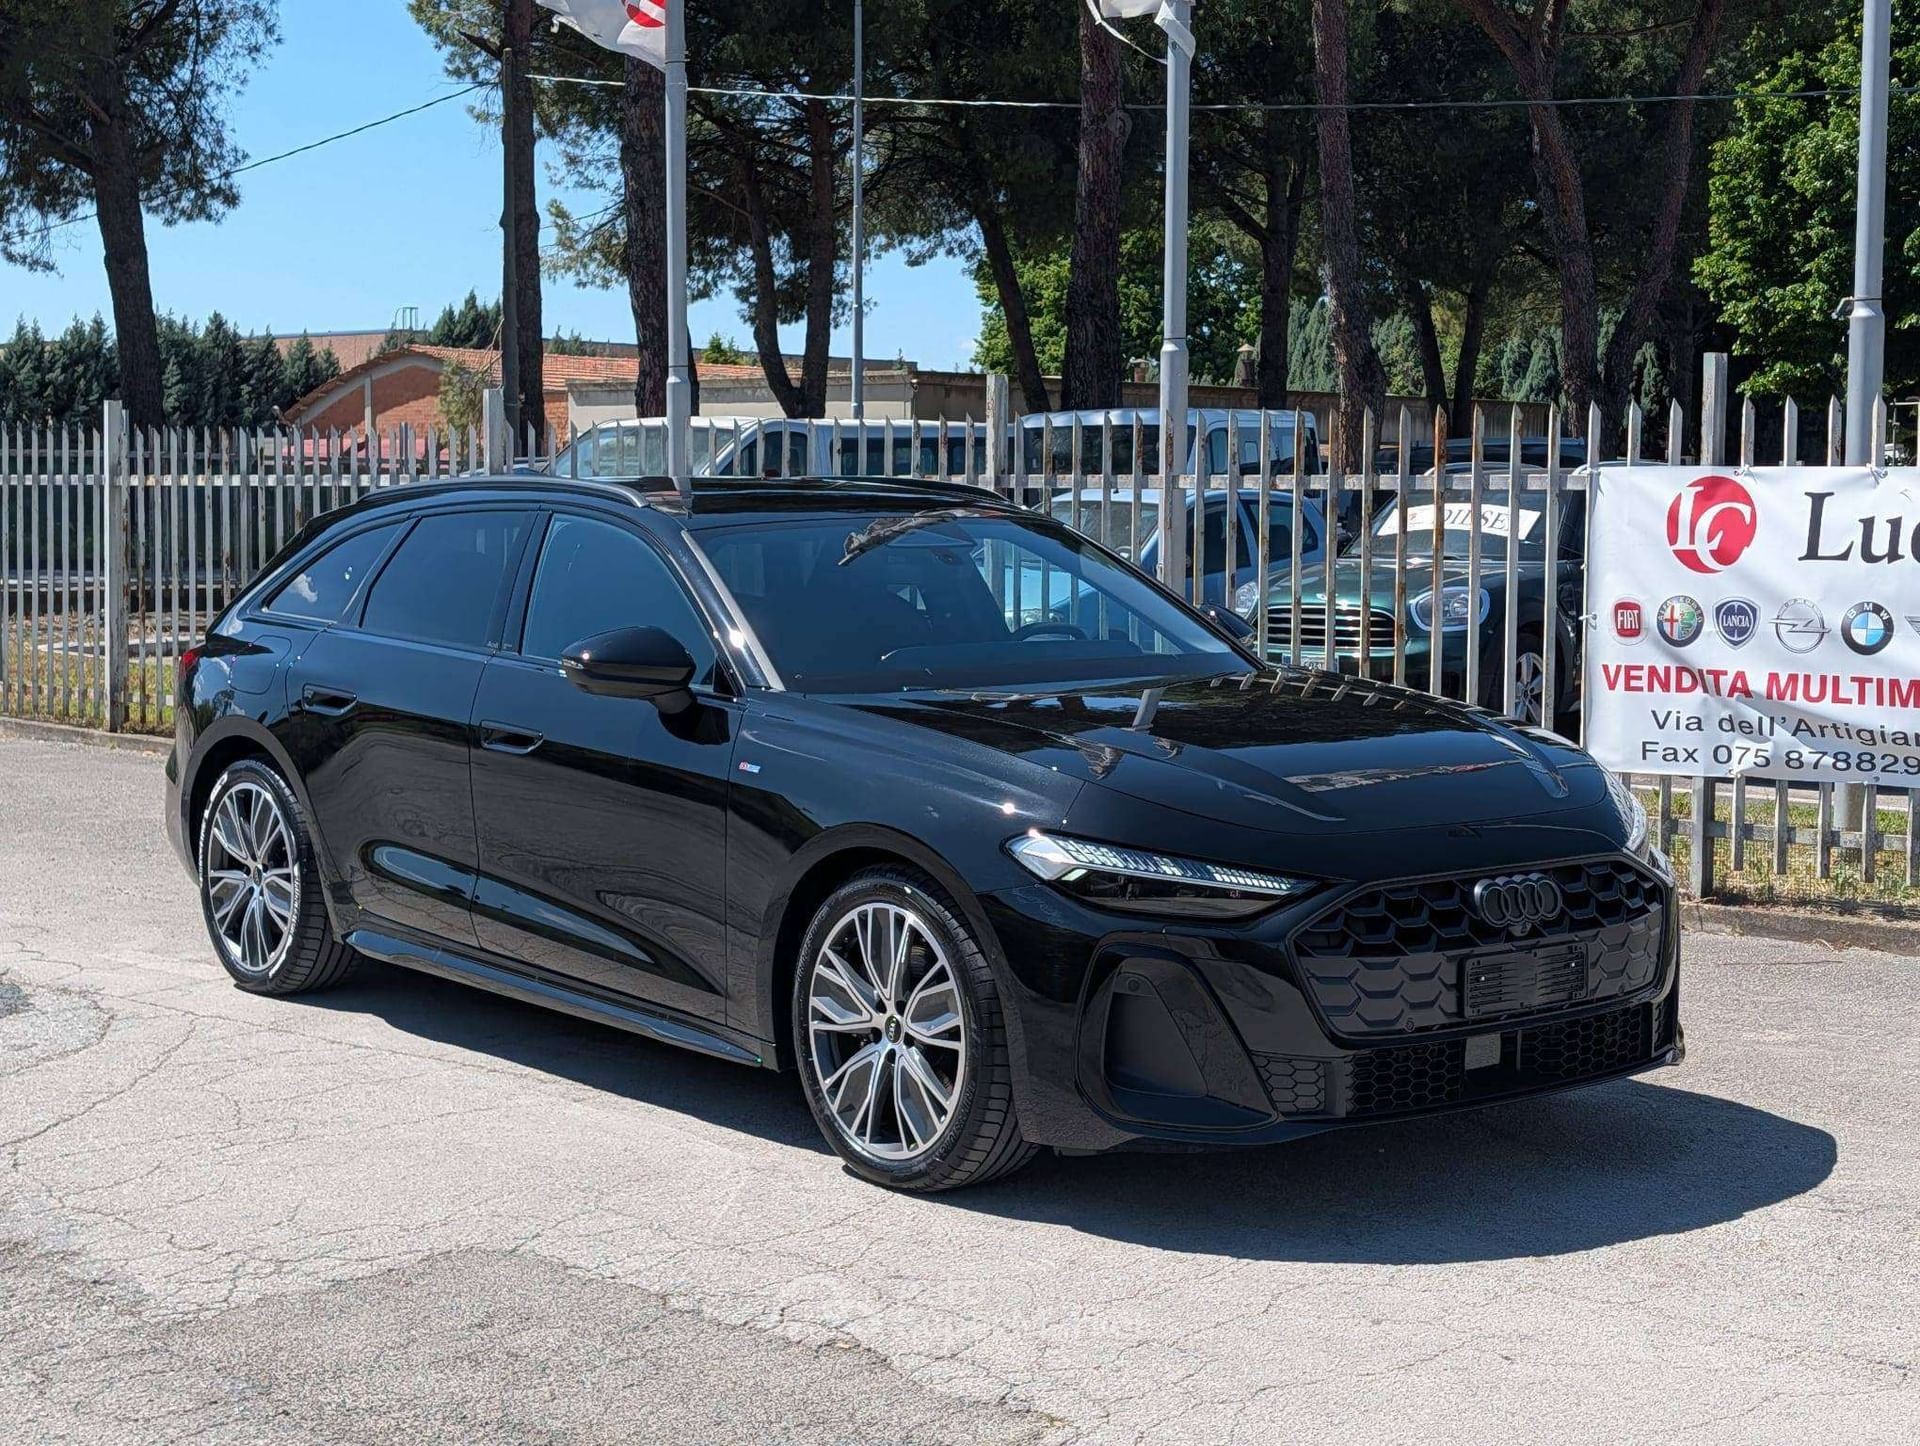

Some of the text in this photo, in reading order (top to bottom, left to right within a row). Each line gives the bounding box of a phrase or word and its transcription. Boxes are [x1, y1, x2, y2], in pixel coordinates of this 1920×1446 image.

[1798, 491, 1920, 565] Lu
[1617, 608, 1640, 630] FIAT
[1722, 614, 1751, 628] LANCIA
[1847, 602, 1891, 620] BMW
[1601, 663, 1920, 709] VENDITA MULTIM
[1650, 709, 1704, 732] Via
[1641, 741, 1920, 776] Fax 075 878829
